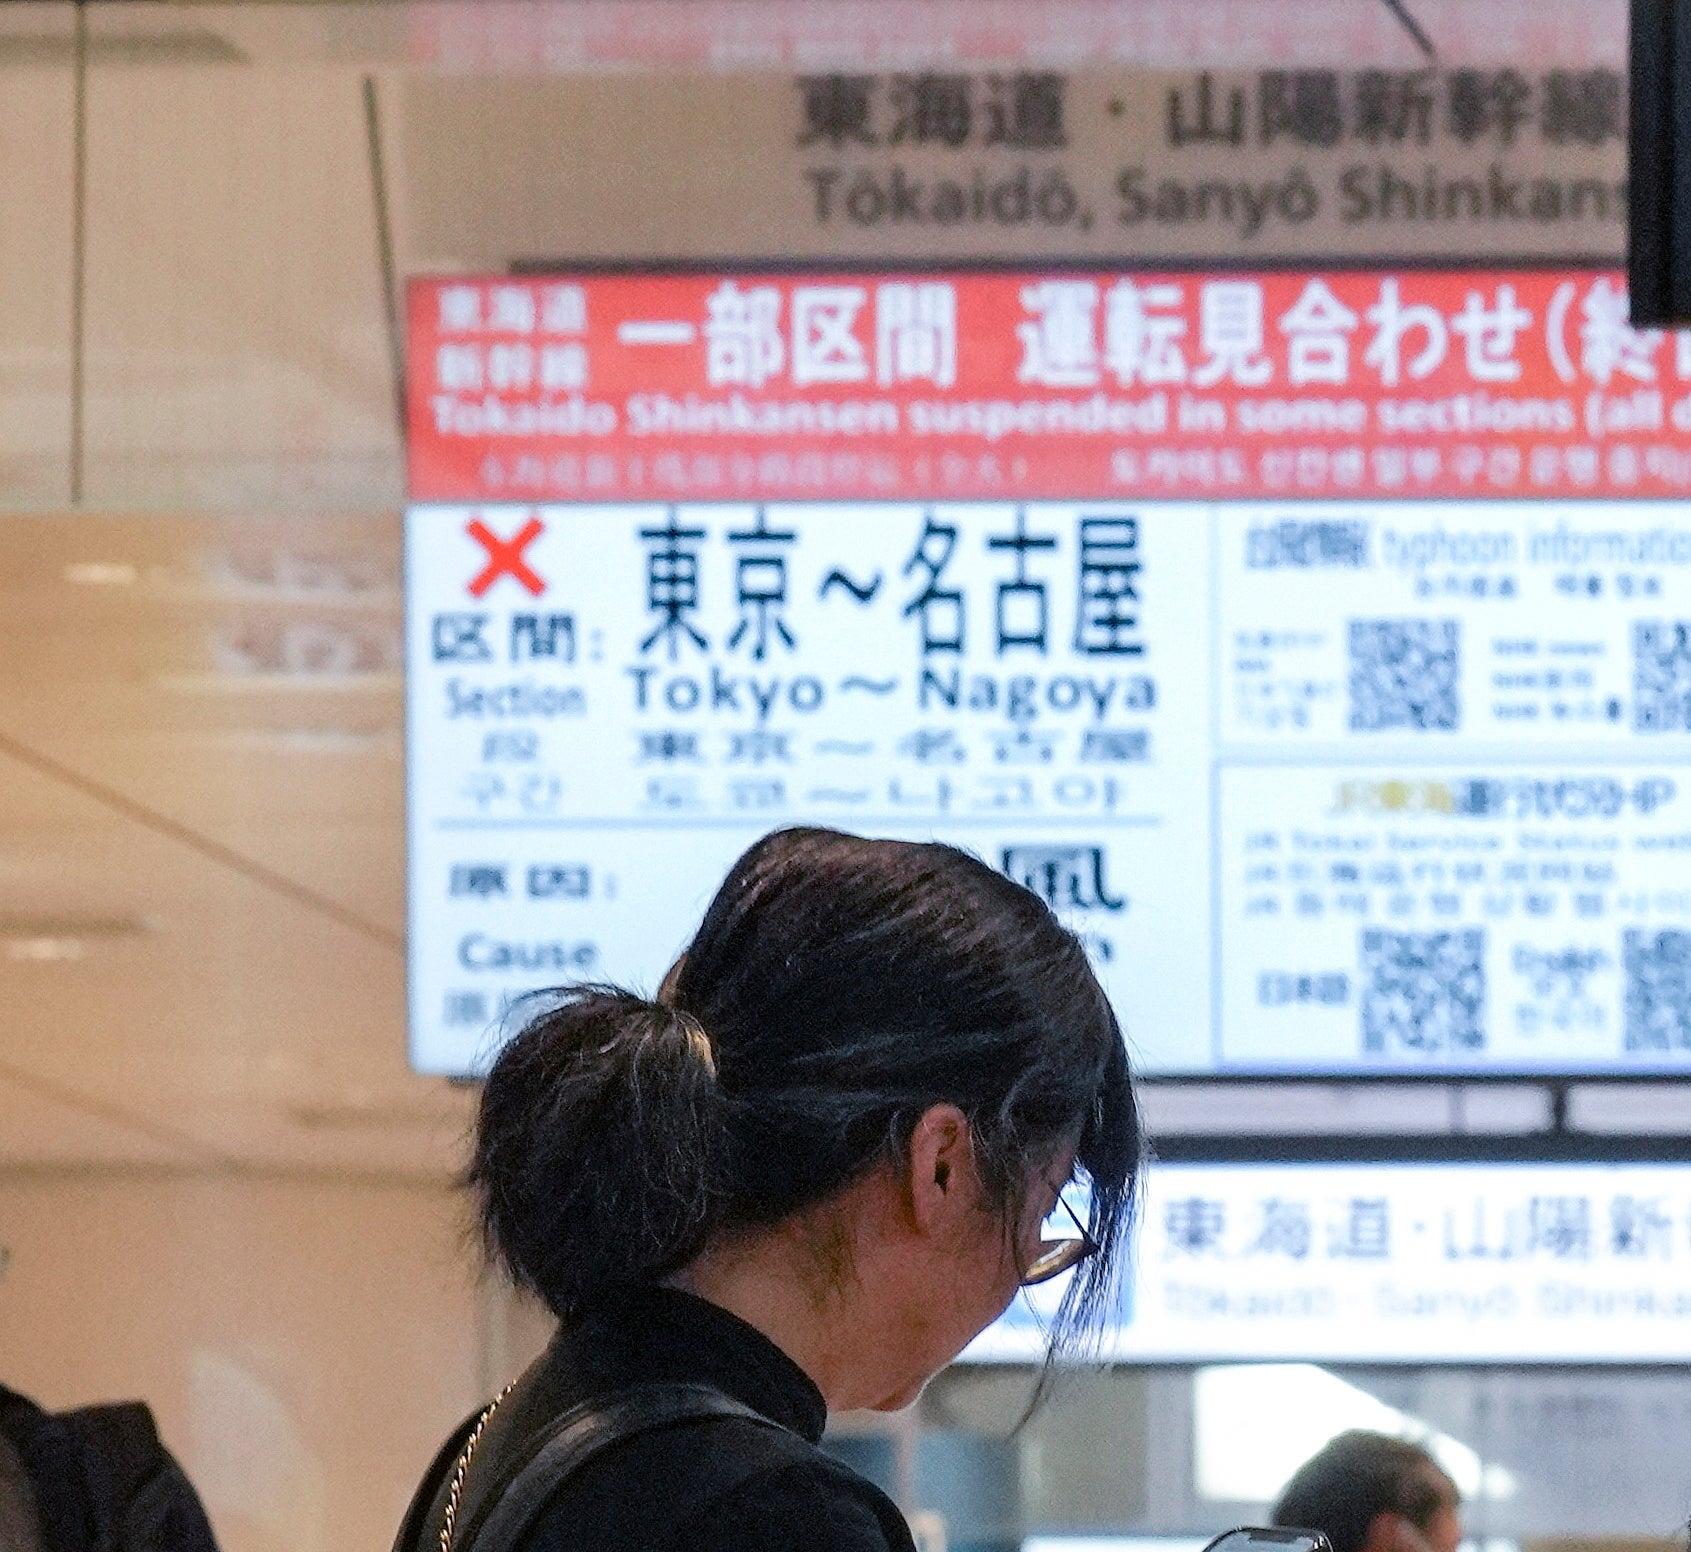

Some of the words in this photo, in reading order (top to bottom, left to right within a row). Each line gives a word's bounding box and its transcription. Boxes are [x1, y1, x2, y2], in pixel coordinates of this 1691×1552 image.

[616, 279, 957, 388] 一部区間
[624, 392, 899, 437] Shinkansen
[906, 392, 1167, 441] suspended
[1177, 393, 1227, 432] in
[1236, 400, 1368, 433] some
[1376, 394, 1575, 432] sections
[443, 674, 586, 720] Section
[457, 932, 598, 971] Cause
